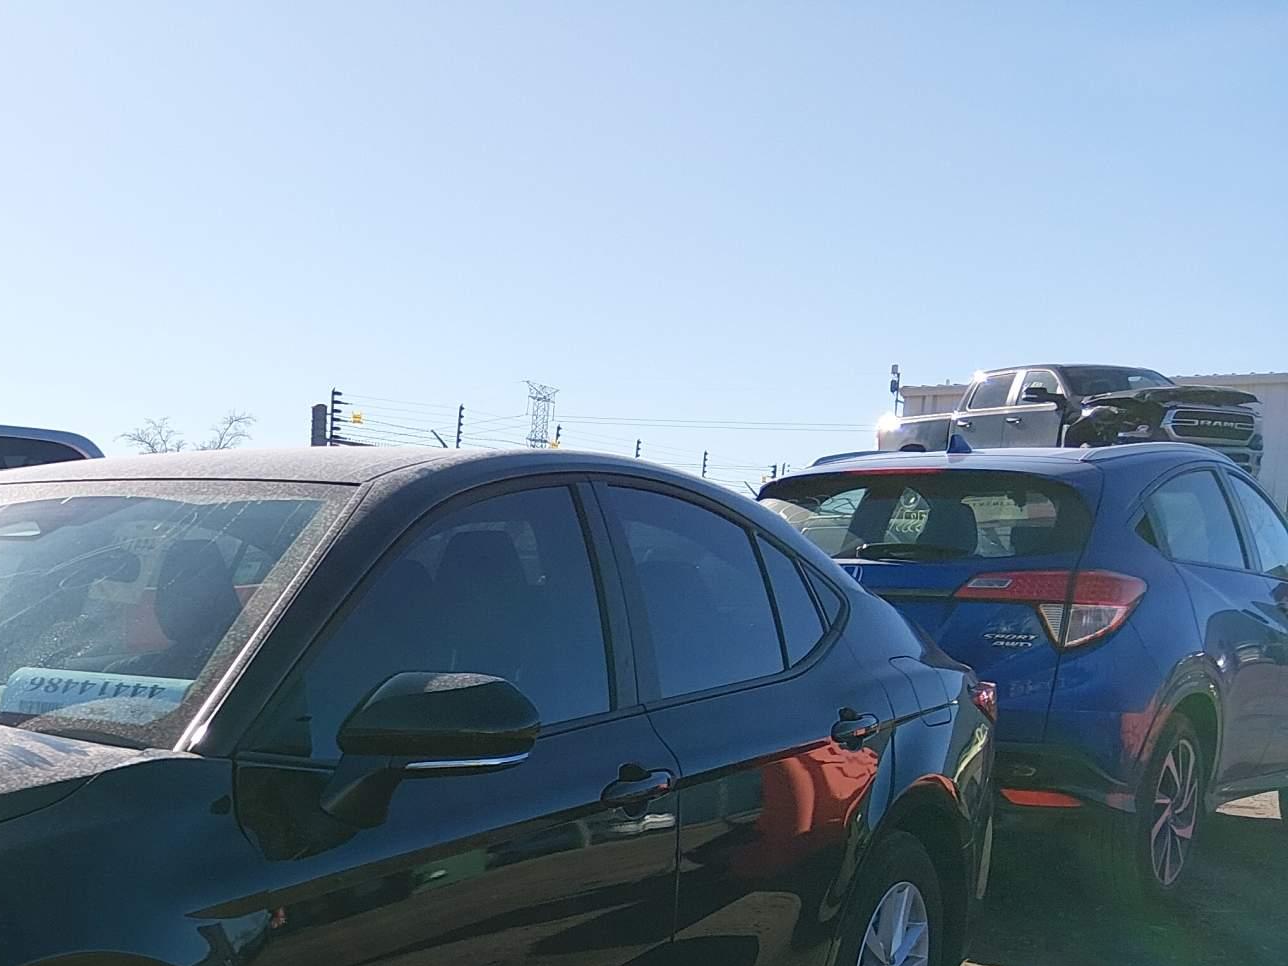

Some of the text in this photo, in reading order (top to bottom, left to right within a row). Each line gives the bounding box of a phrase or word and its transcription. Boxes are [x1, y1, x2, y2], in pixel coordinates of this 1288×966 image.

[1200, 419, 1235, 429] RAM
[983, 633, 1040, 641] SPORT
[991, 641, 1033, 649] AWD
[29, 676, 166, 700] 44414486
